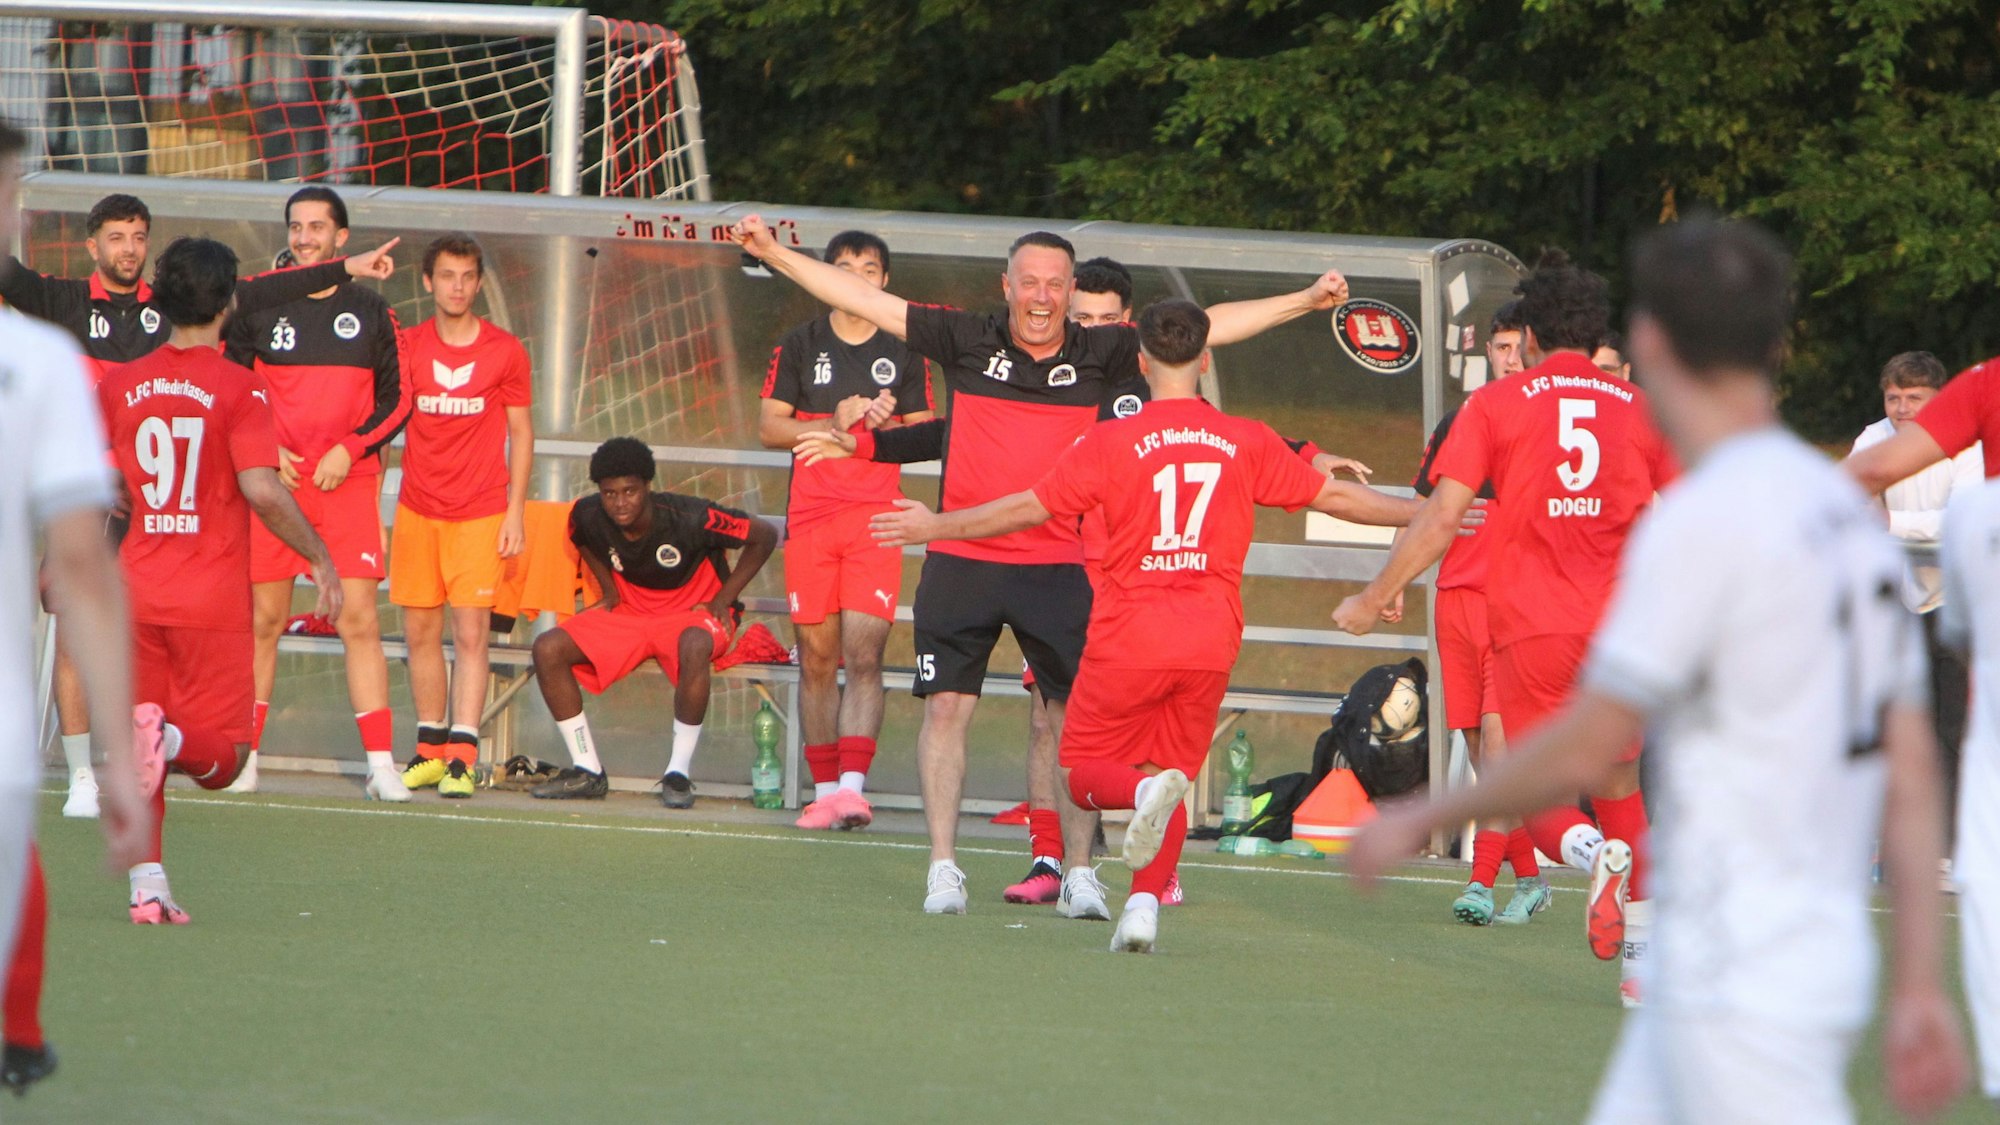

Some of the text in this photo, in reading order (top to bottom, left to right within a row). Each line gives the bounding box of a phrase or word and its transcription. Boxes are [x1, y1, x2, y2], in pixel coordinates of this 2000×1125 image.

[90, 313, 110, 338] 10
[271, 326, 296, 350] 33
[814, 362, 832, 385] 16
[983, 356, 1013, 381] 15
[152, 377, 215, 410] Niederkassel
[1551, 374, 1633, 403] Niederkassel
[417, 391, 485, 416] erima
[1161, 426, 1237, 459] Niederkassel
[1556, 397, 1600, 492] 5
[135, 416, 204, 511] 97
[1152, 462, 1222, 551] 17
[1548, 497, 1602, 518] DOGU
[916, 653, 936, 682] 15
